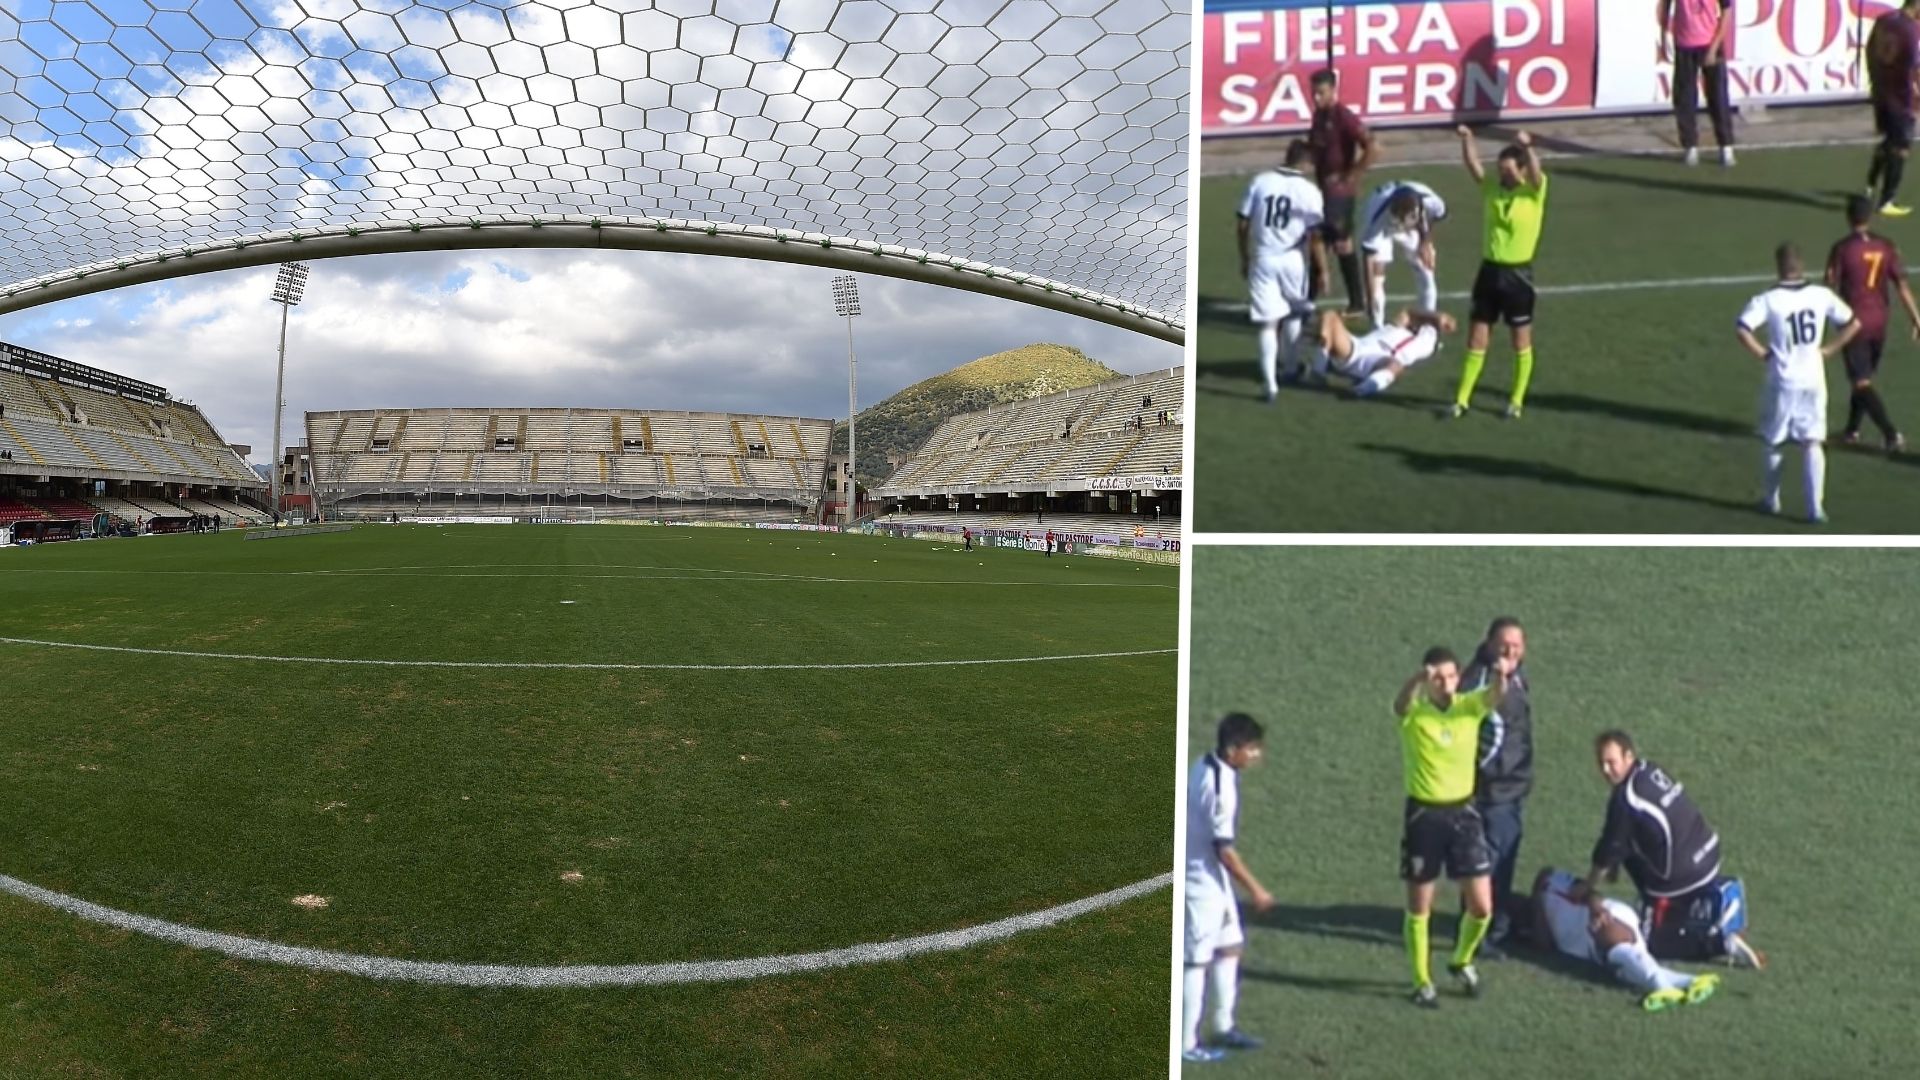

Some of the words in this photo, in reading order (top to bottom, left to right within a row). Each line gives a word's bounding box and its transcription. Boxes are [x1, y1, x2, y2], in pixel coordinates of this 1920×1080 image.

[1223, 2, 1460, 64] FIERA
[1494, 0, 1566, 49] DI
[1728, 63, 1810, 97] NON
[1264, 194, 1291, 230] 18
[1863, 252, 1883, 288] 7
[1786, 309, 1816, 346] 16
[1002, 537, 1017, 547] Serie
[1018, 539, 1023, 548] B
[1066, 534, 1093, 544] PASTORE
